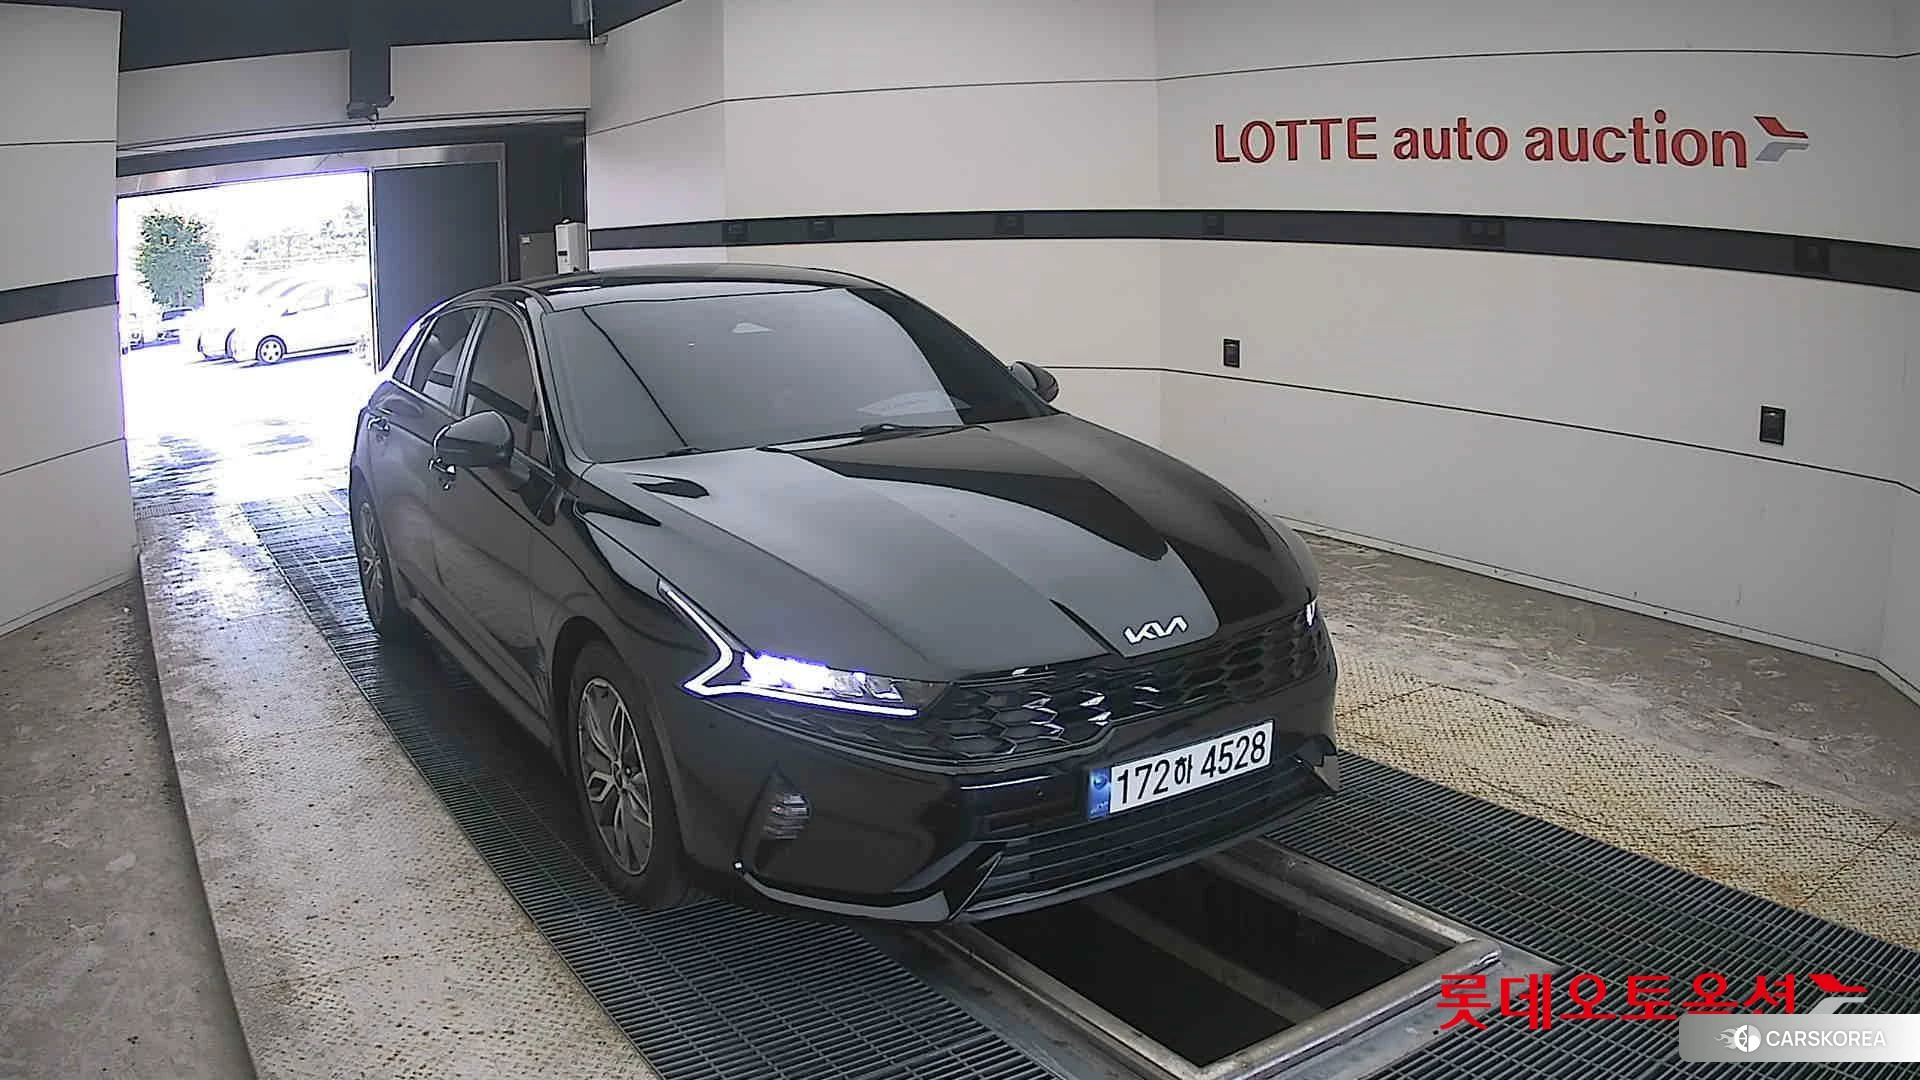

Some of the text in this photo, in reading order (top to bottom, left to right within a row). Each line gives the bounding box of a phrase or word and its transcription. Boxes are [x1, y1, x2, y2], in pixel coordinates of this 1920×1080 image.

[1215, 109, 1748, 168] LOTTE auto auction
[1117, 731, 1266, 804] 172하 4528
